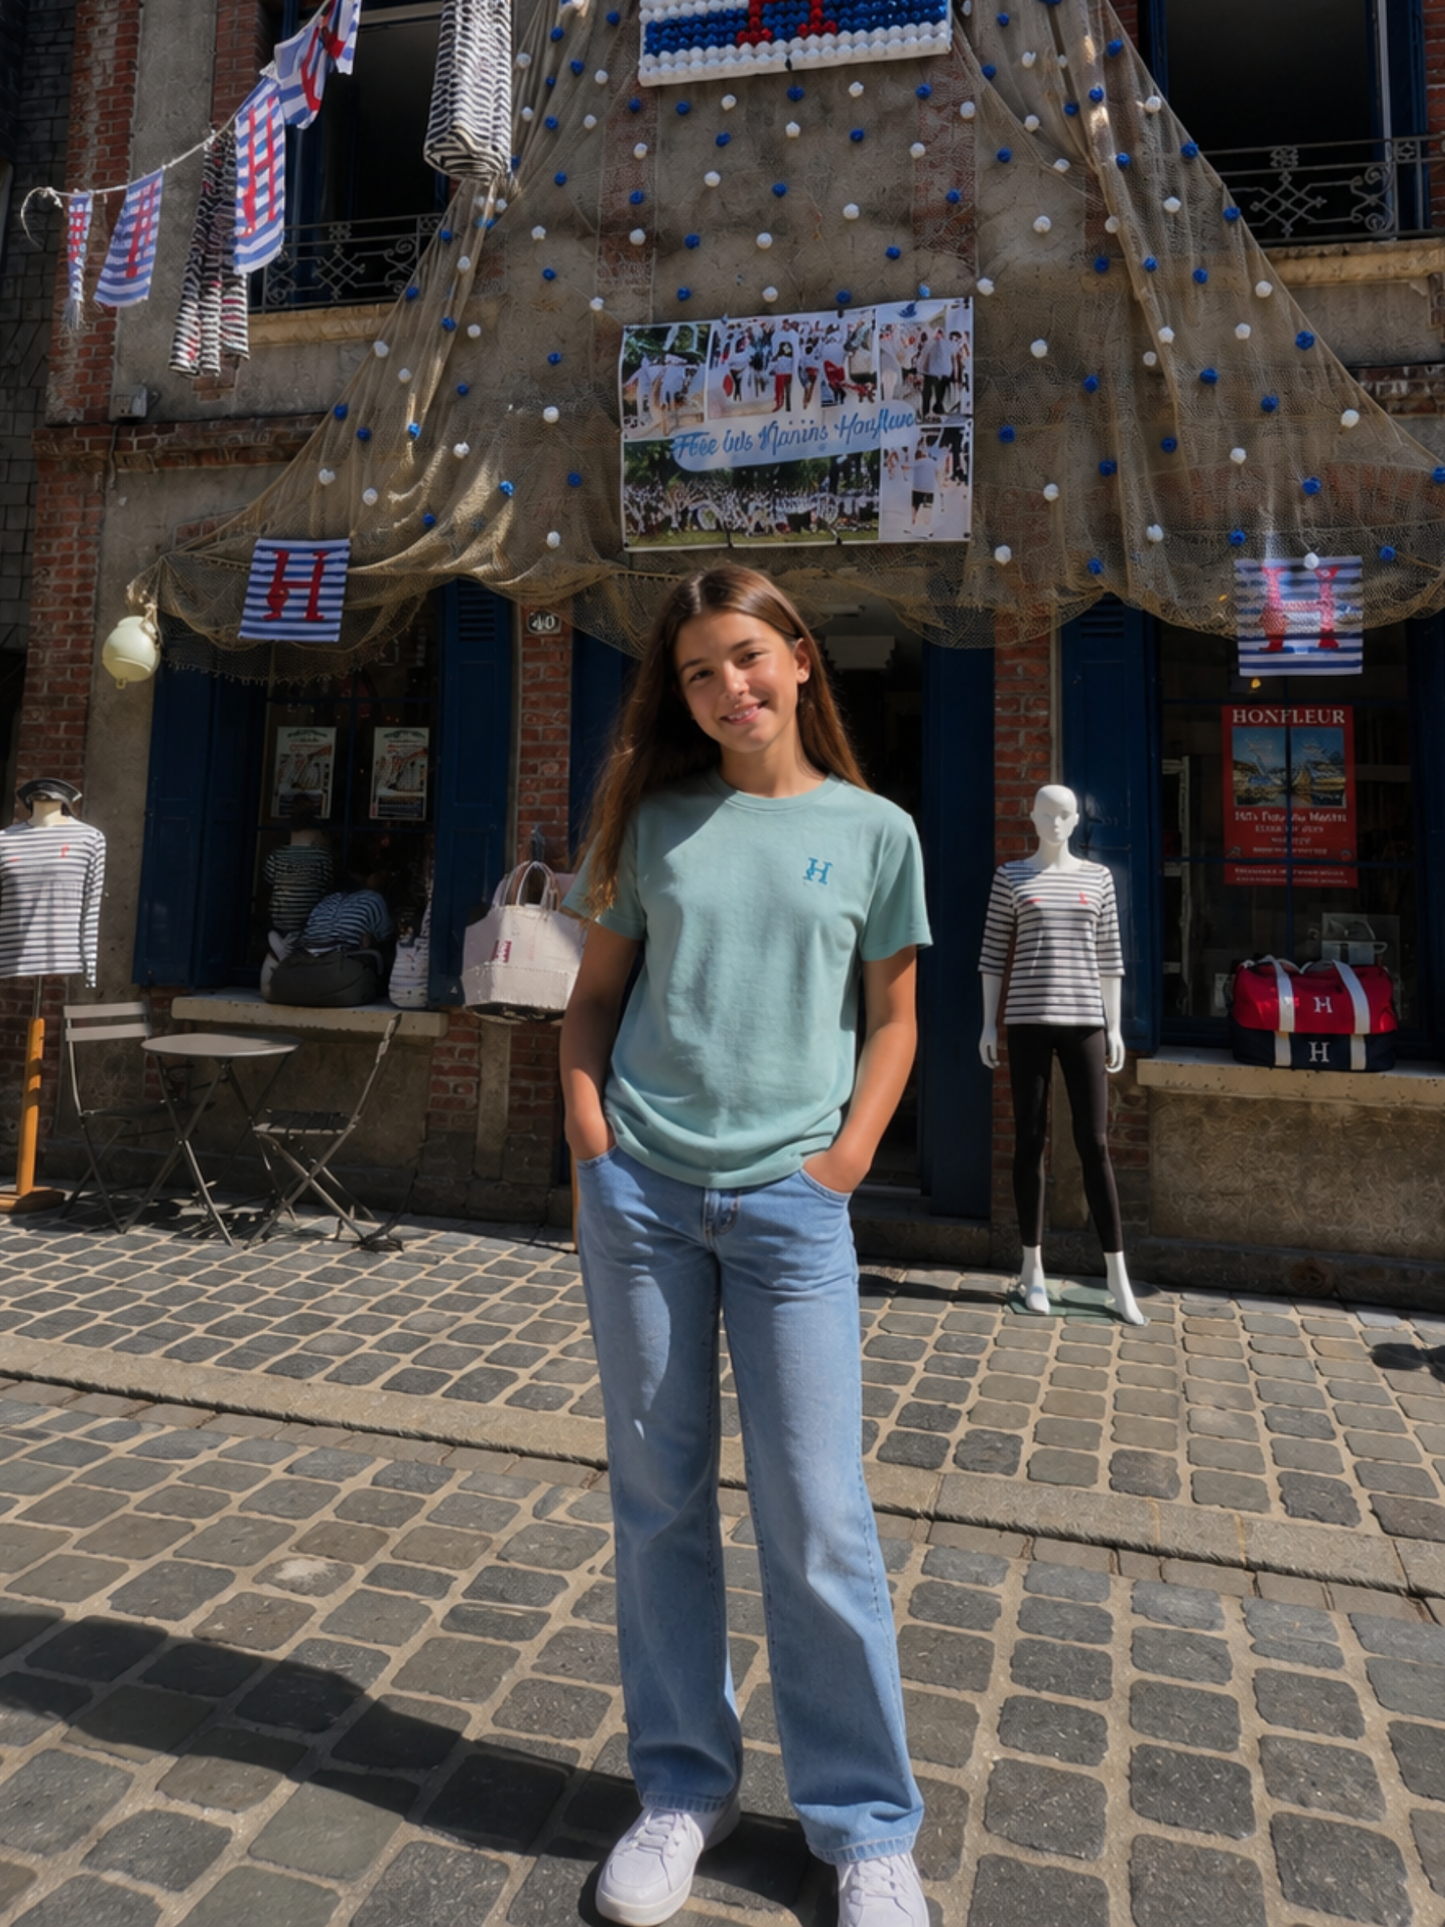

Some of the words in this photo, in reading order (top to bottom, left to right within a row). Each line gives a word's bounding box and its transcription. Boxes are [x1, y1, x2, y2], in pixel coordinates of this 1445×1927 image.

[262, 549, 330, 621] H
[1258, 565, 1341, 652] H
[531, 614, 556, 631] 40
[1231, 708, 1346, 725] HONFLEUR
[802, 856, 834, 886] H
[1313, 996, 1333, 1013] H
[1308, 1042, 1330, 1062] H
